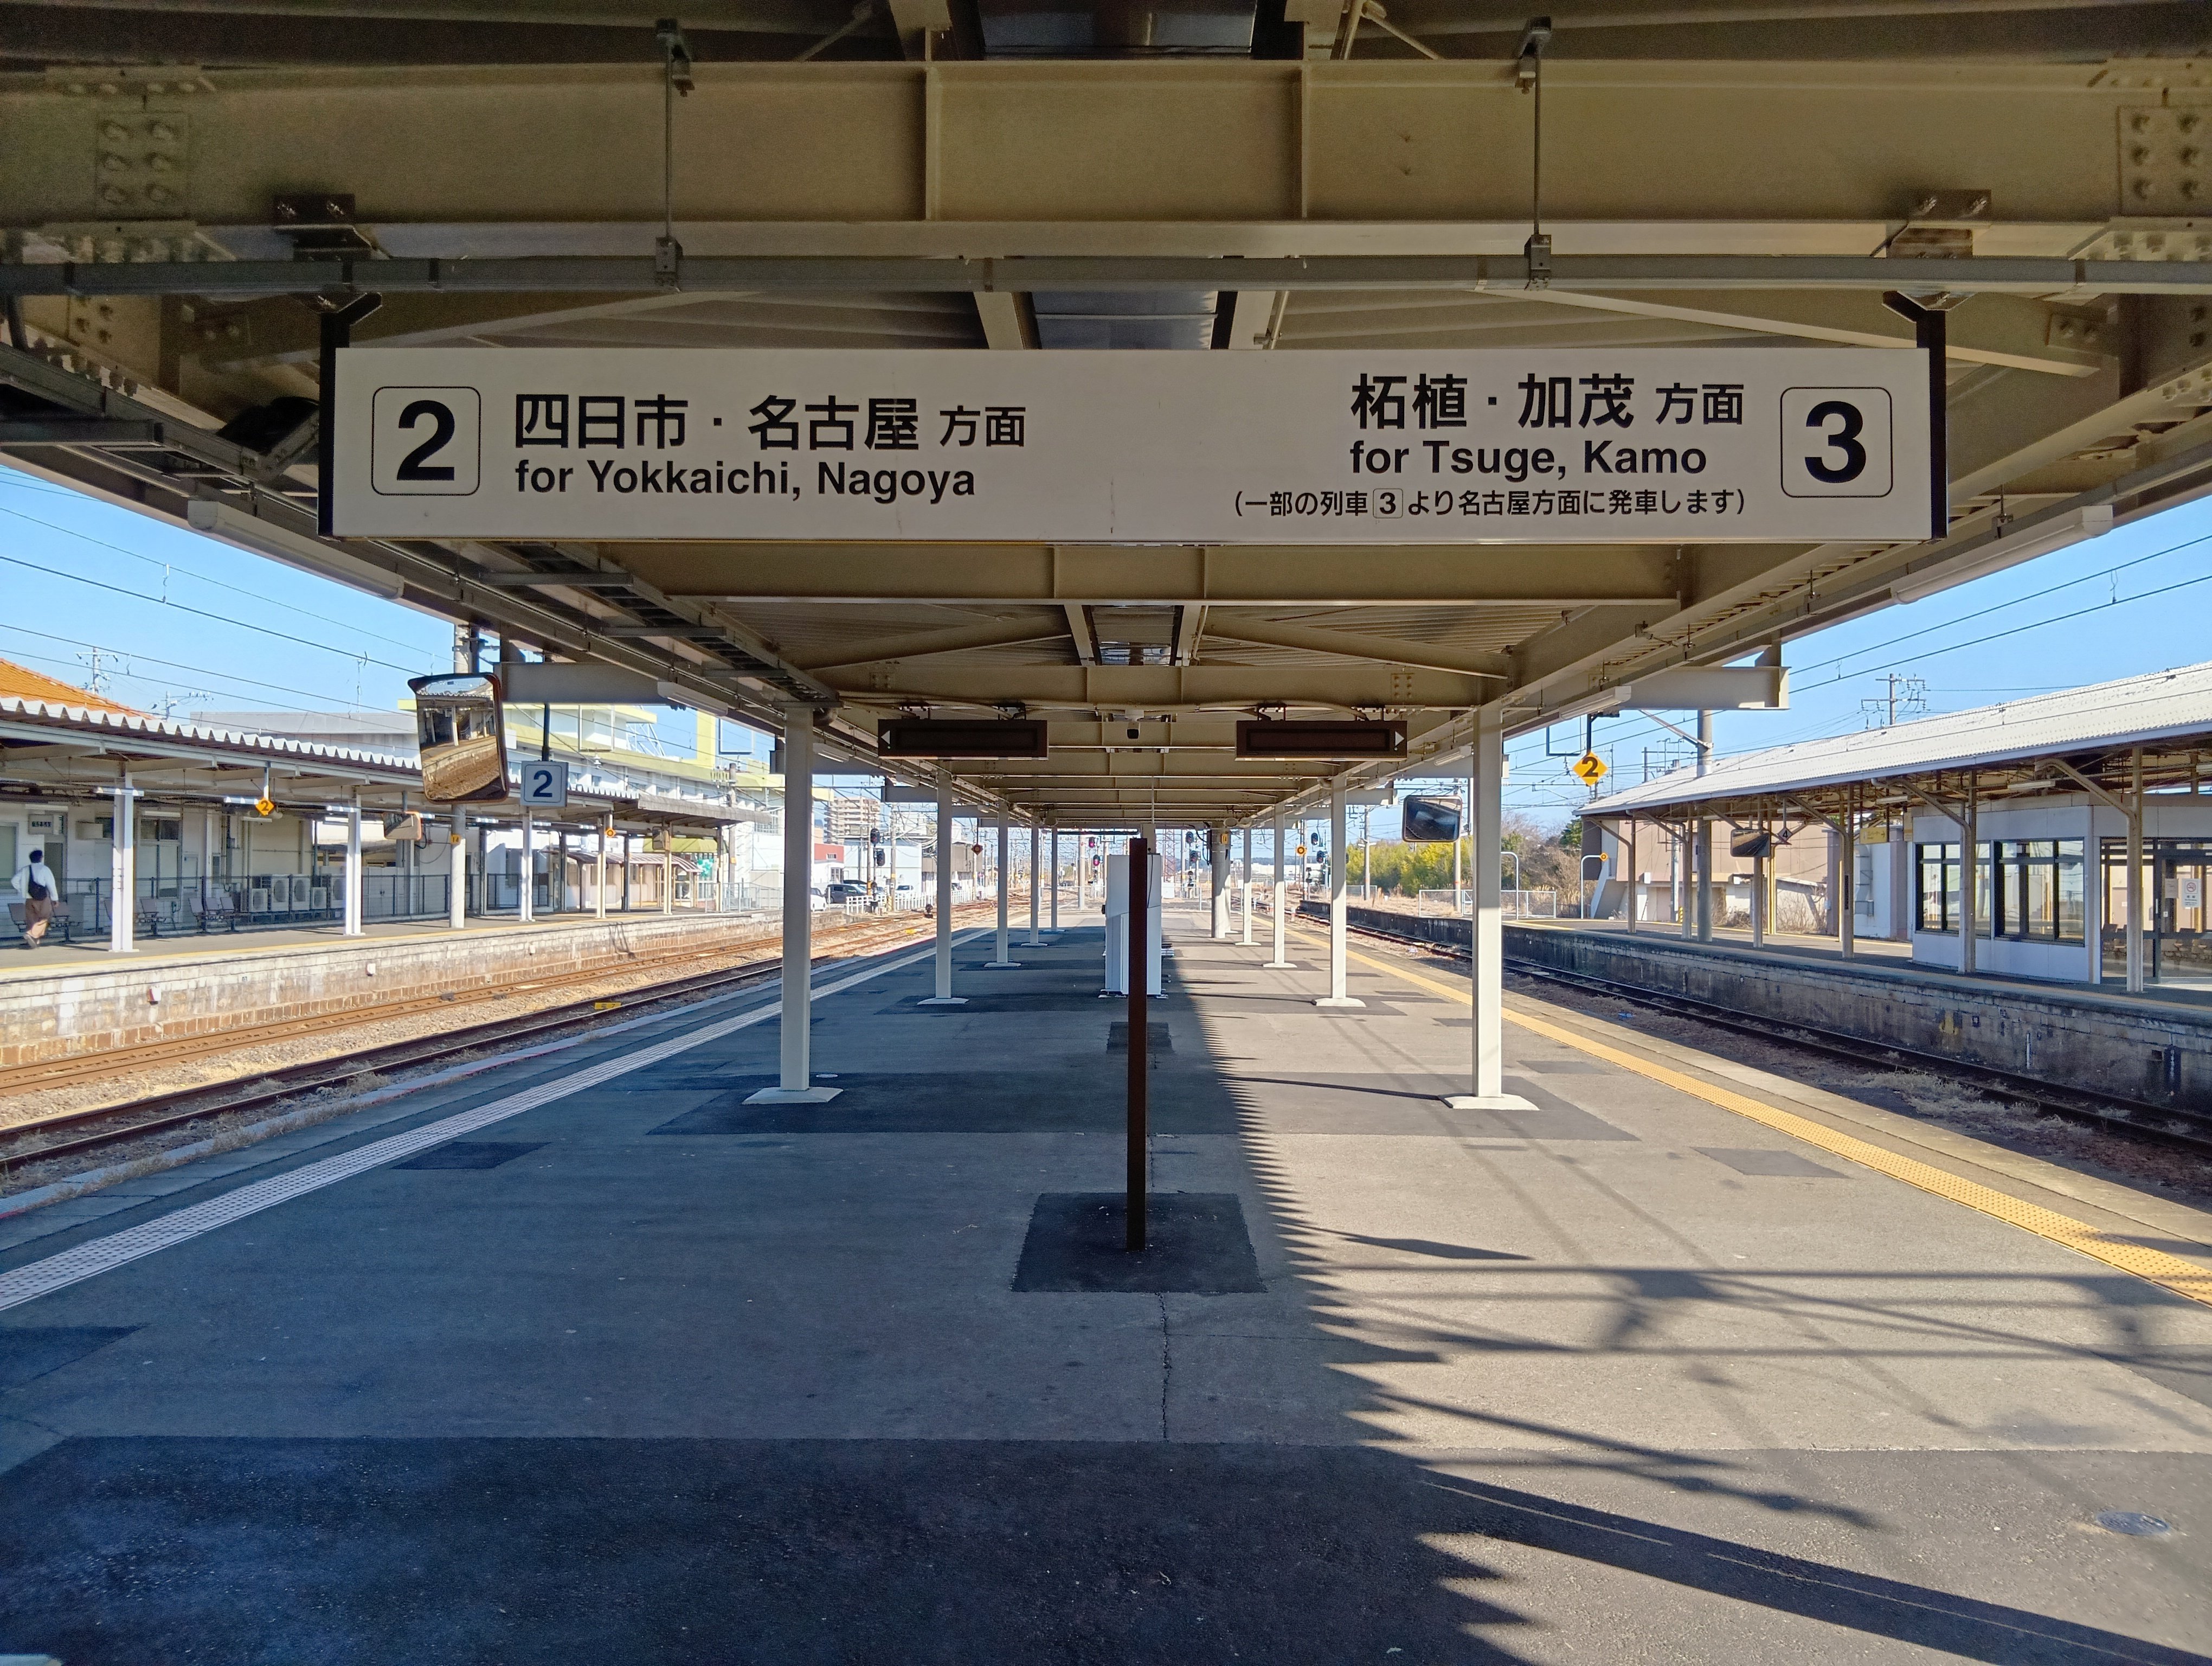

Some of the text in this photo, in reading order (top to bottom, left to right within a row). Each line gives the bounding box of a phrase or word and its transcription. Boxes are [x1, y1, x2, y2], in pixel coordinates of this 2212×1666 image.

[515, 394, 1027, 451] 四日市・名古屋 方面
[1351, 373, 1745, 430] 柘植・加茂 方面
[396, 400, 455, 481] 2
[1349, 439, 1707, 483] for Tsuge, Kamo
[1804, 401, 1867, 484] 3
[515, 459, 975, 505] for Yokkaichi, Nagoya
[533, 770, 552, 798] 2
[1581, 756, 1599, 778] 2
[260, 800, 269, 811] 2
[1783, 830, 1788, 839] 4
